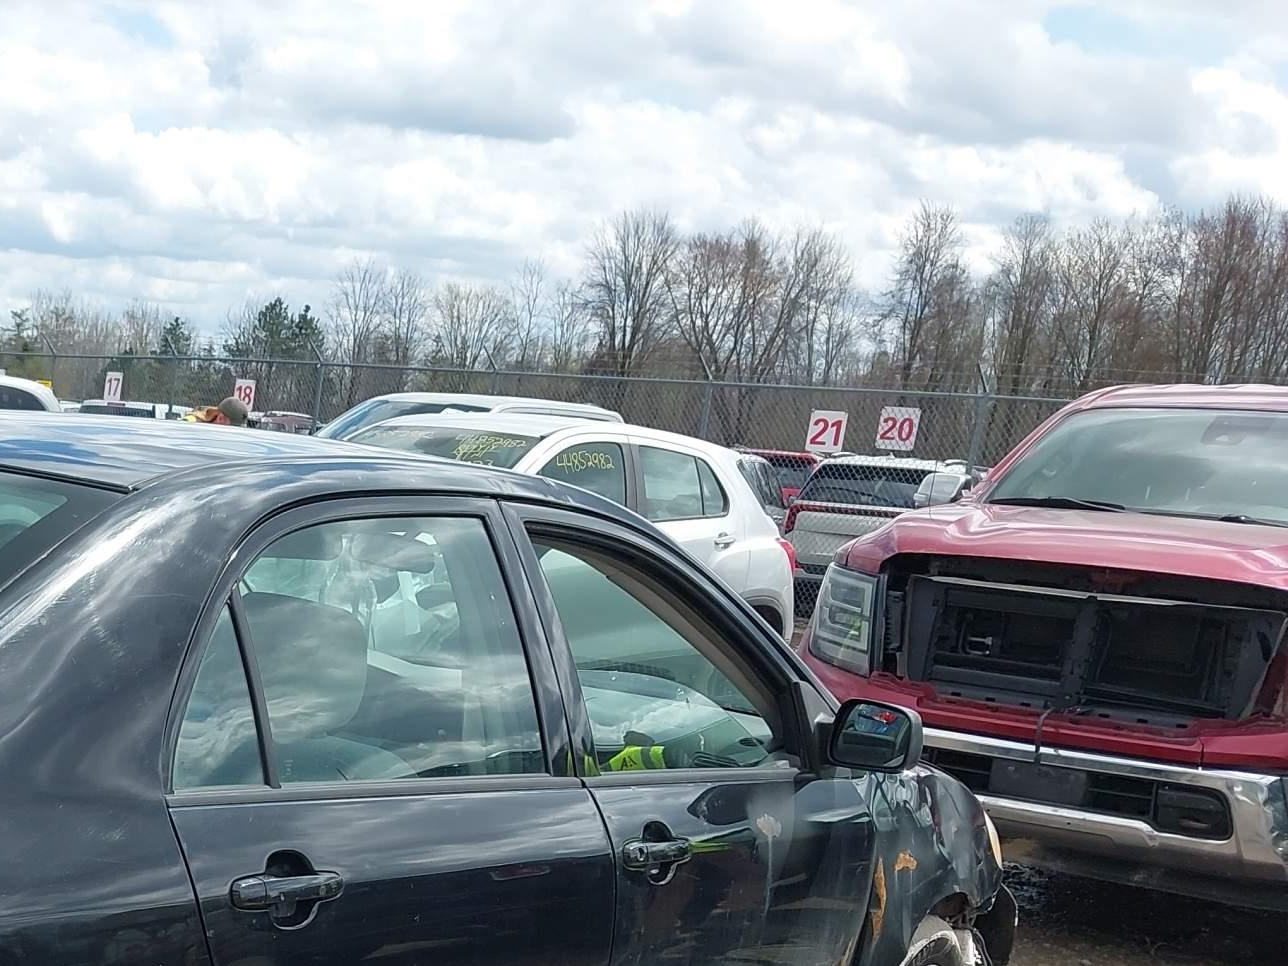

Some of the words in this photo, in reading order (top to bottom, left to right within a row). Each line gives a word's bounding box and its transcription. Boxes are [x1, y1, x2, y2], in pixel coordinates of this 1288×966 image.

[107, 377, 121, 396] 17
[236, 385, 252, 405] 18
[809, 418, 843, 446] 21
[880, 416, 914, 442] 20
[556, 450, 615, 474] 44852982
